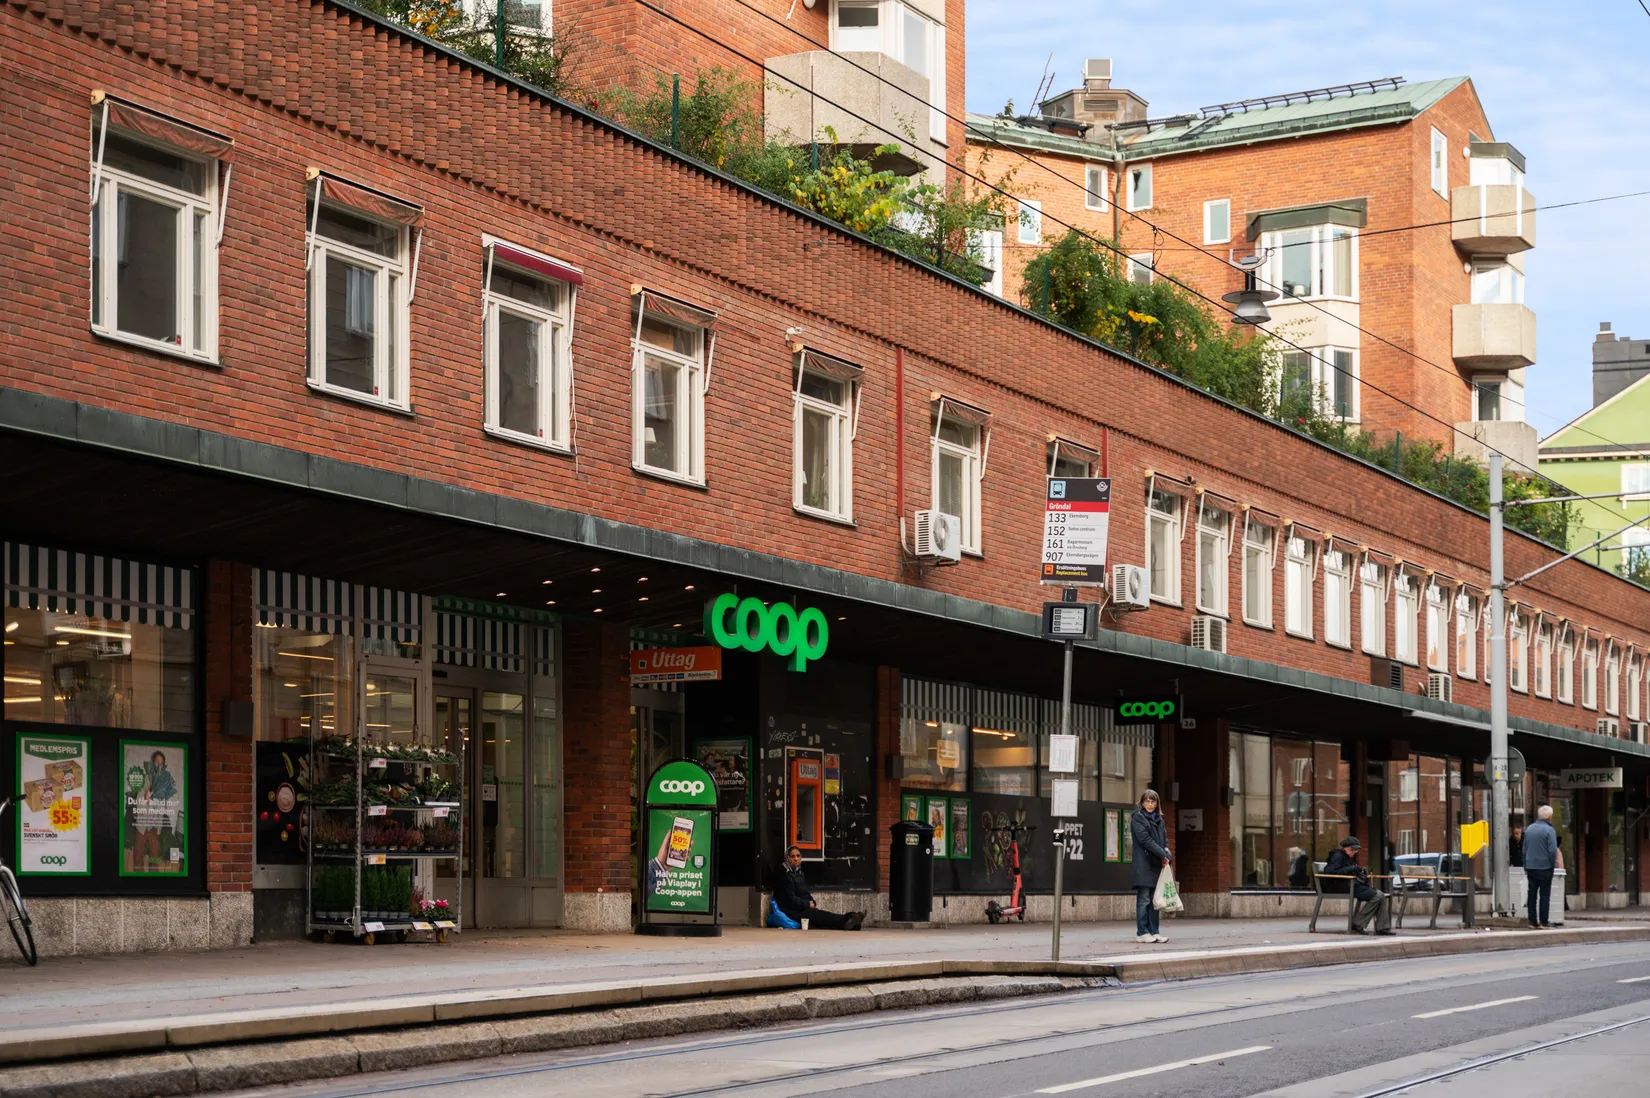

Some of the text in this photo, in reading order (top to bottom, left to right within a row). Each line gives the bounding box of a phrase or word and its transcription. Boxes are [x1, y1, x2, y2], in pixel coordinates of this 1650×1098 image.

[1049, 502, 1071, 510] Gröndal
[1048, 513, 1066, 523] 133
[1048, 526, 1065, 536] 152
[1046, 539, 1064, 549] 161
[1046, 552, 1063, 561] 907
[706, 592, 829, 673] coop
[652, 652, 696, 670] Uttag
[1120, 701, 1175, 719] coop
[29, 744, 78, 754] MEDLEMSPRIS
[800, 763, 817, 778] Uttag
[1568, 773, 1614, 783] APOTEK
[660, 780, 705, 796] coop
[1065, 823, 1083, 836] PPET
[672, 835, 688, 845] 50%
[40, 856, 67, 866] coop
[655, 870, 702, 880] Halva priset
[657, 880, 667, 888] på
[668, 879, 696, 889] Viaplay
[655, 888, 702, 897] Coop-appen
